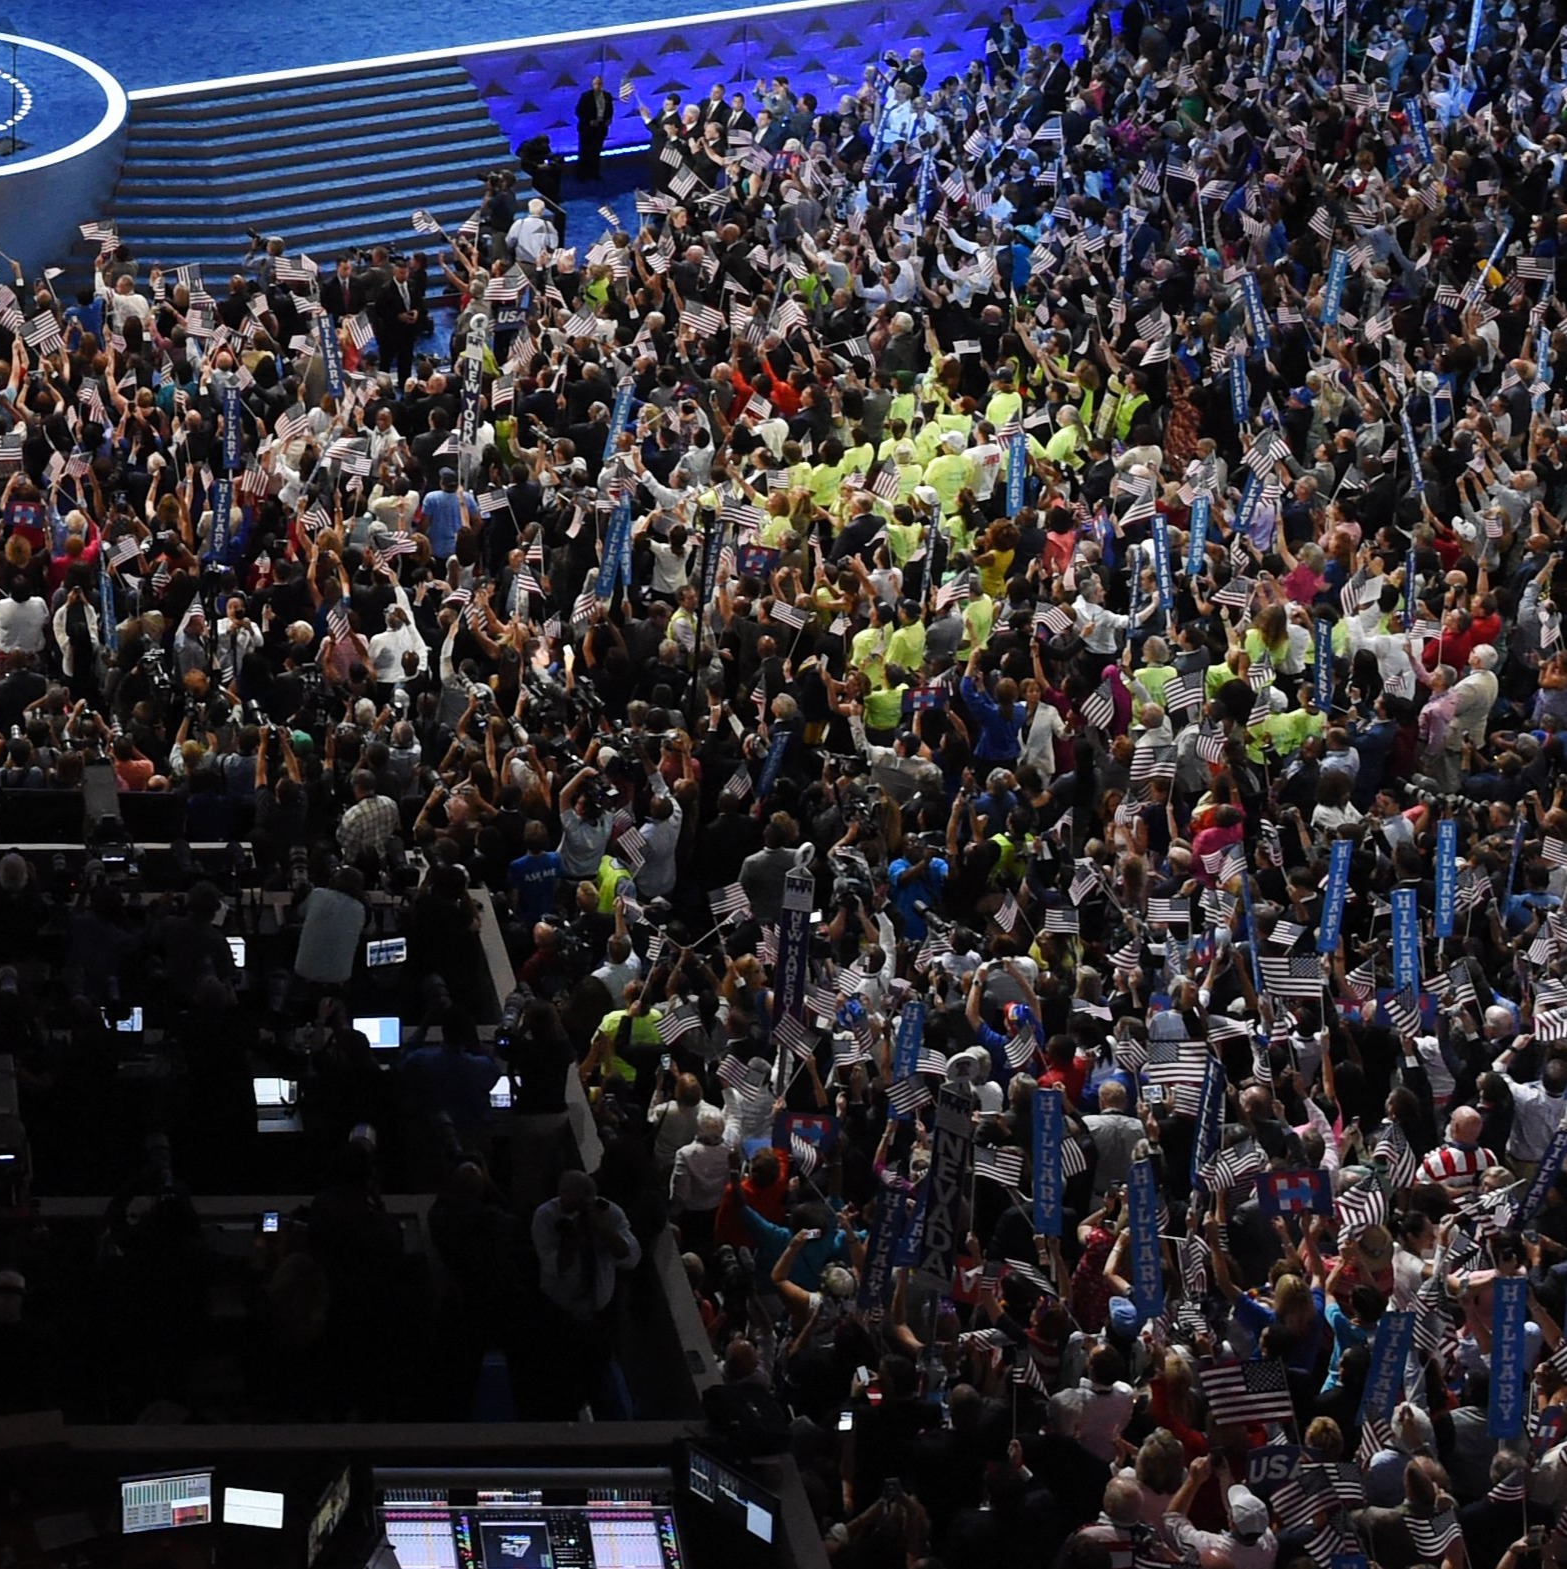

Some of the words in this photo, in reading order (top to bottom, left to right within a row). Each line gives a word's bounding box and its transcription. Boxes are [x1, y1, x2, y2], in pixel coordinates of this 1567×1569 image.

[1406, 100, 1429, 159] HILLARY
[498, 311, 526, 324] USA
[1244, 275, 1266, 341] HILLARY
[1326, 254, 1345, 317] HILLARY
[320, 319, 340, 389] HILLARY
[464, 358, 479, 393] NEW
[226, 389, 237, 461] HILLARY
[463, 396, 476, 443] YORK
[1010, 436, 1023, 508] HILLARY
[214, 484, 229, 552] HILLARY
[601, 512, 626, 587] HILLARY
[1194, 499, 1207, 566] HILLARY
[704, 522, 723, 595] HILLARY
[1155, 517, 1169, 599] HILLARY
[1318, 621, 1328, 702] HILLARY
[1326, 846, 1348, 941] HILLARY
[1441, 825, 1454, 925] HILLARY
[787, 912, 803, 942] NEW
[1396, 895, 1413, 984] HILLAR
[783, 945, 799, 1013] HAMPSHI
[900, 1007, 919, 1077] HILLA
[1039, 1095, 1056, 1219] HILLARY
[1521, 1131, 1567, 1221] HILLARY
[921, 1131, 964, 1280] NEVADA
[1133, 1168, 1155, 1300] HILLARY
[868, 1193, 901, 1297] HILLARY
[1497, 1284, 1518, 1421] HILLARY
